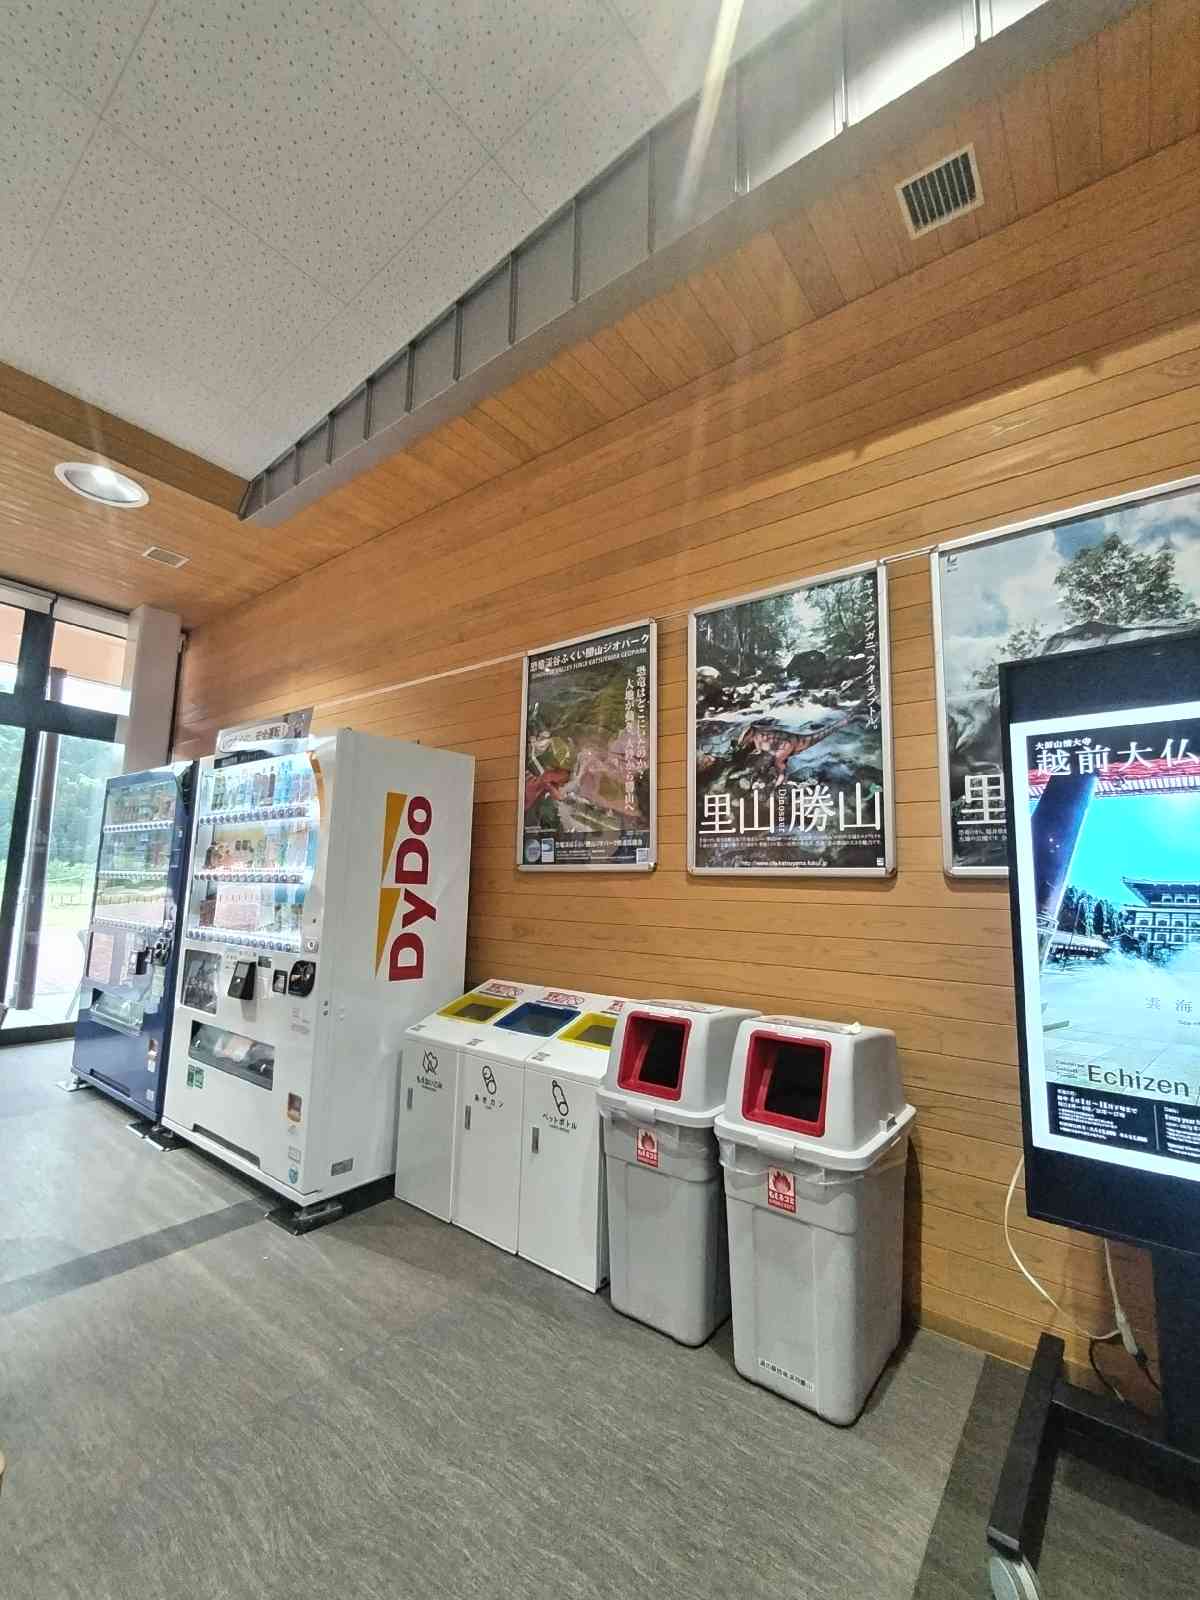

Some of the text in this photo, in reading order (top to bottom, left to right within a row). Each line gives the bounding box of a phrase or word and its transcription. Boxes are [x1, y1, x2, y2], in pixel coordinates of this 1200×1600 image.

[1035, 738, 1200, 777] 越前大仏
[777, 788, 788, 833] Dinosaur
[388, 795, 437, 981] DyDo
[1087, 1064, 1189, 1097] Echizen
[542, 1113, 578, 1130] ペットボトル
